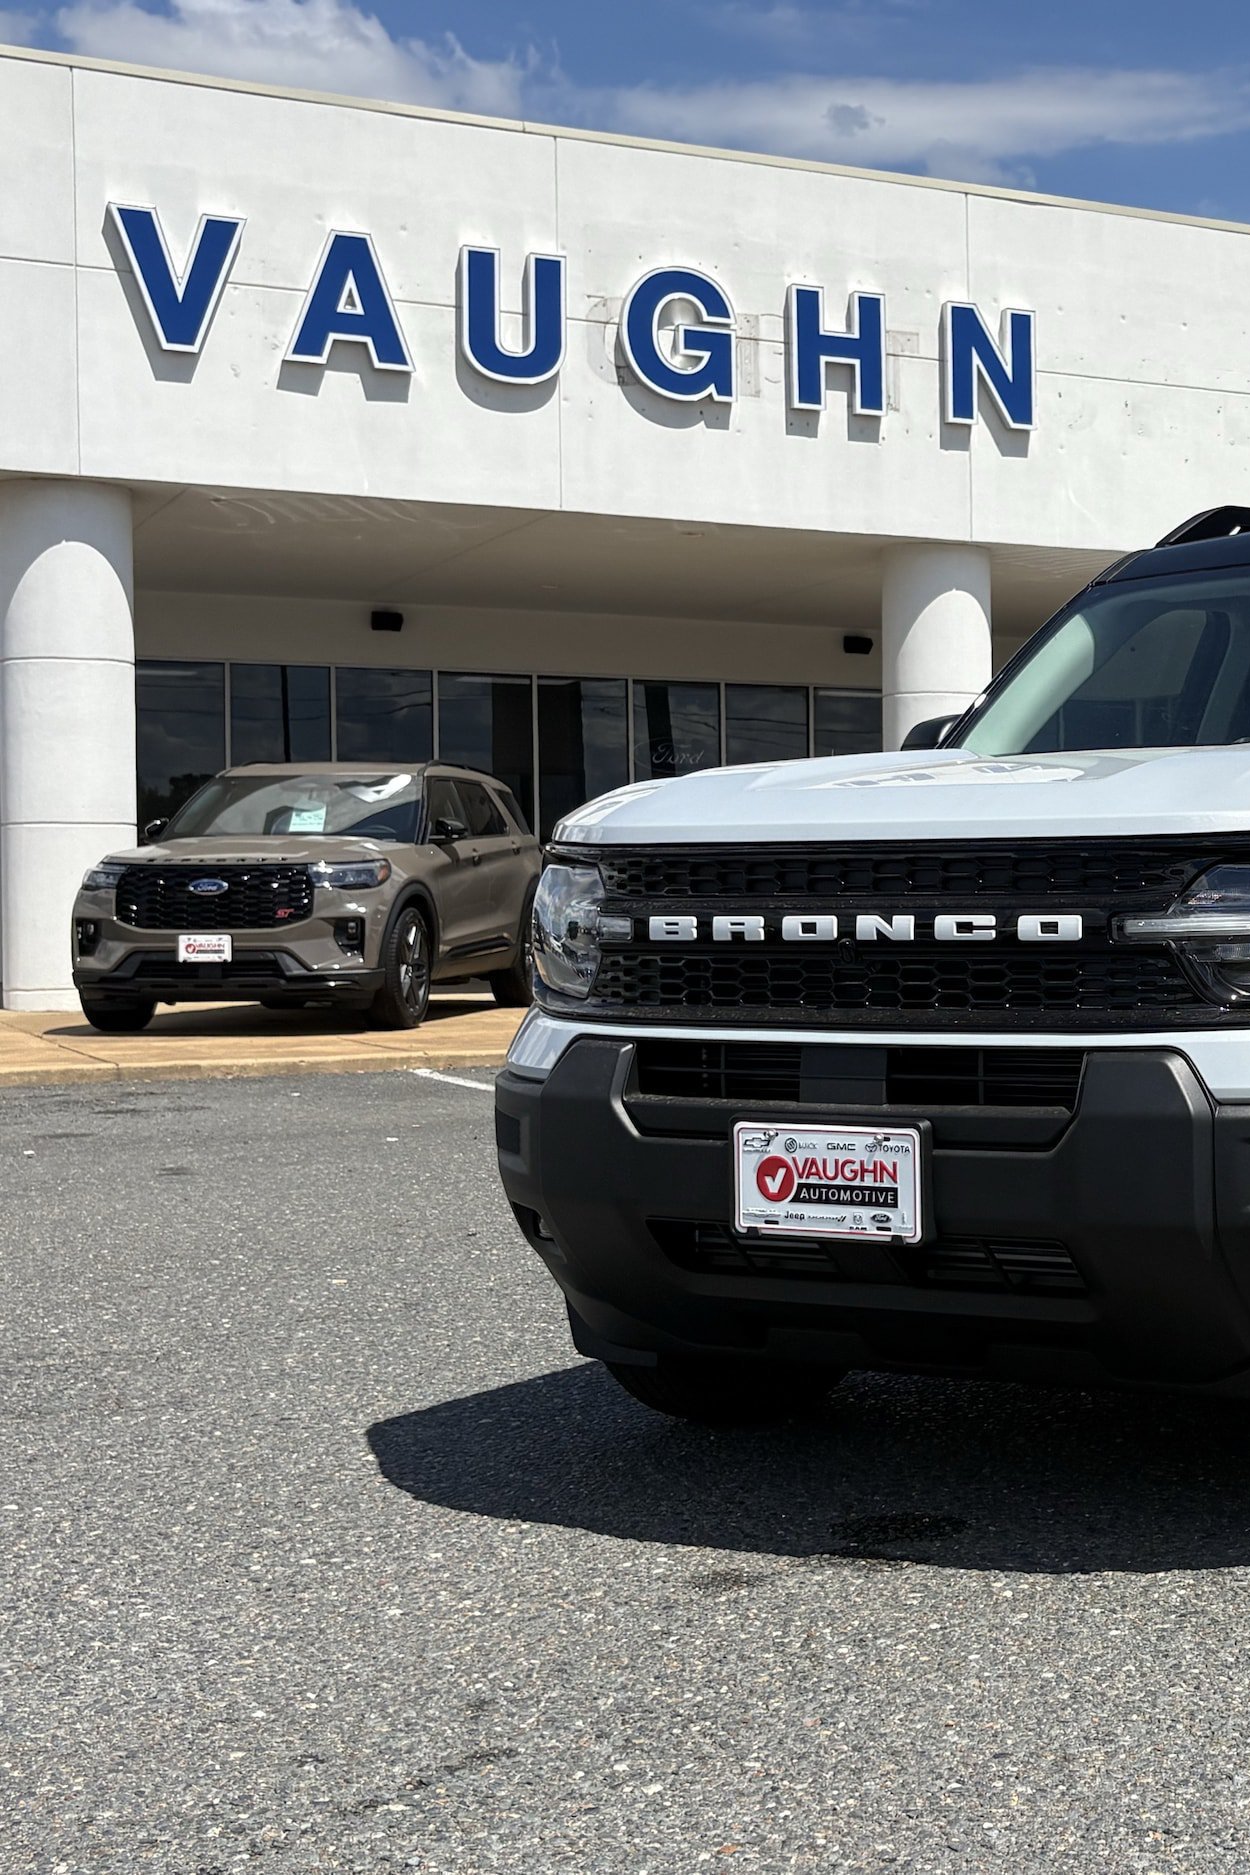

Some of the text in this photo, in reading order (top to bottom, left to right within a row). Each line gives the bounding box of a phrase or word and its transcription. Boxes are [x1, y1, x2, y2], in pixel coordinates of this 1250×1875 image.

[107, 202, 1037, 431] VAUGHN
[651, 743, 705, 765] Ford
[275, 908, 294, 918] ST
[649, 915, 1083, 942] BRONCO
[826, 1142, 856, 1151] GMC
[879, 1144, 911, 1154] TOYOTA
[792, 1156, 898, 1184] VAUGHN
[799, 1187, 896, 1204] AUTOMOTIVE
[784, 1210, 805, 1221] Jeep
